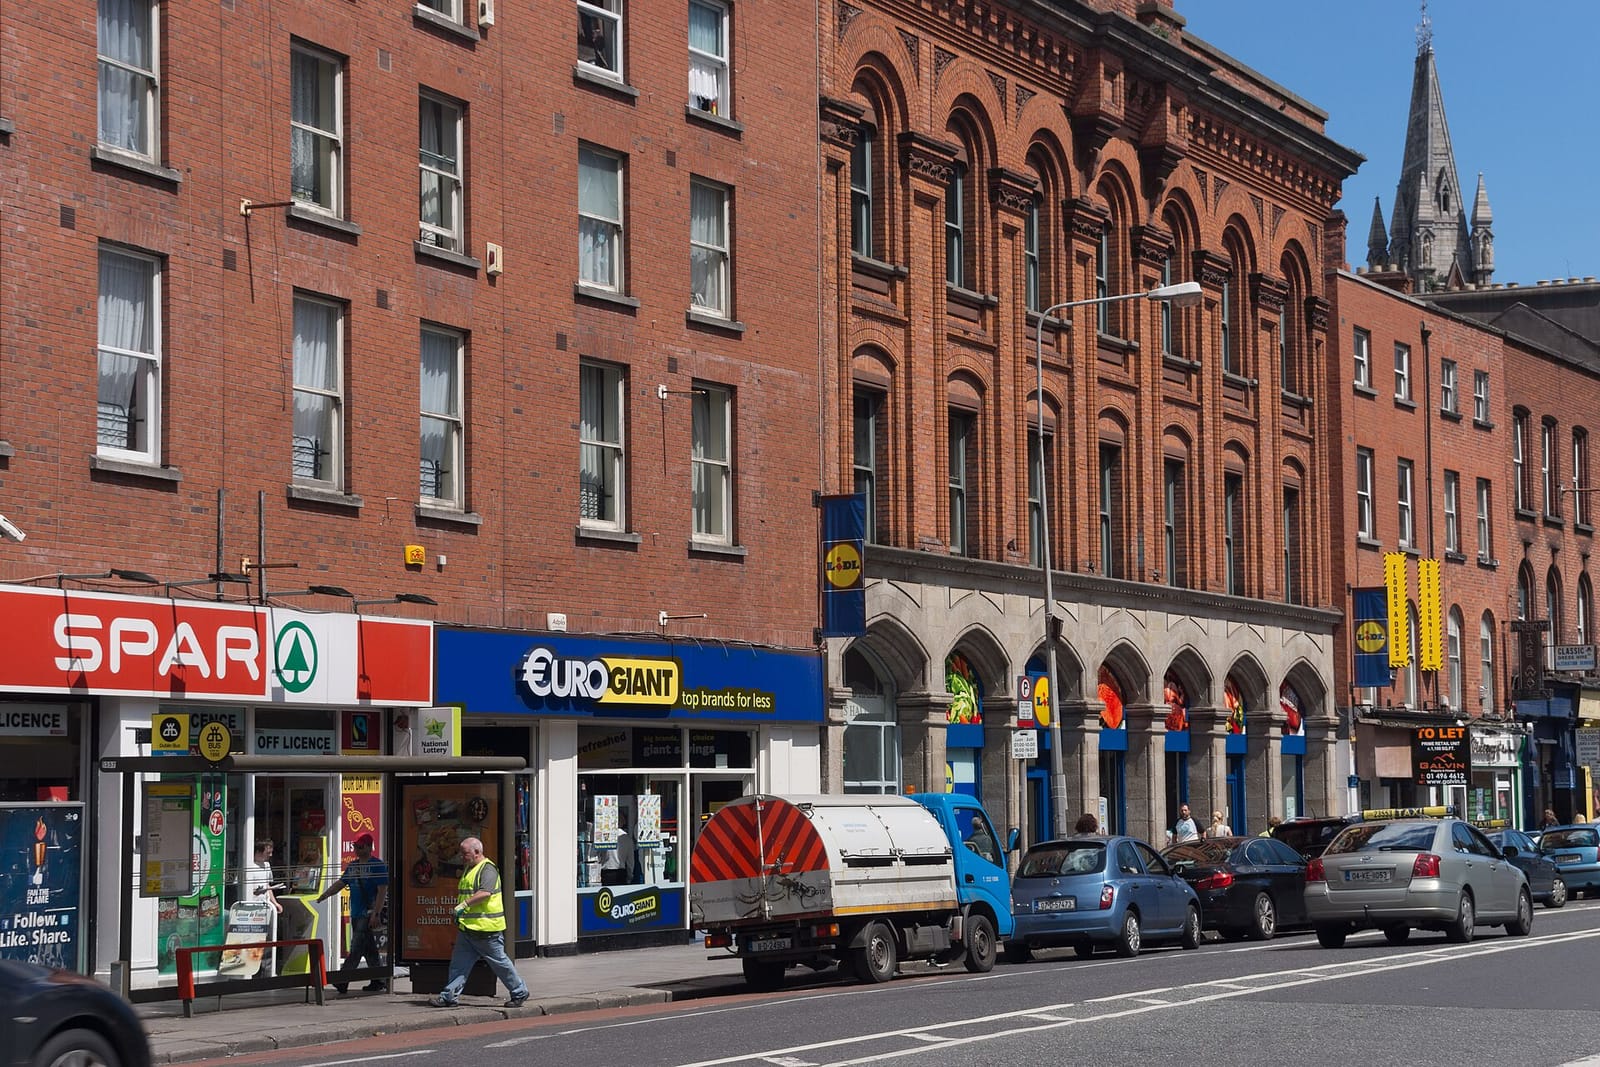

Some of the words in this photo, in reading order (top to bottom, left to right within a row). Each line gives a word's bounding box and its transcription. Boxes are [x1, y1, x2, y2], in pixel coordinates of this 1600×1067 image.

[53, 613, 260, 681] SPAR
[682, 690, 699, 710] top
[701, 690, 735, 707] brands
[737, 691, 751, 708] for
[752, 692, 771, 709] less
[1440, 728, 1465, 739] LET
[257, 736, 279, 749] OFF
[283, 736, 331, 750] LICENCE
[578, 732, 627, 754] refreshed
[643, 743, 674, 757] giant
[675, 743, 716, 757] svings
[355, 776, 365, 791] DAY
[1397, 808, 1423, 817] TAXI
[27, 889, 39, 898] FAN
[39, 888, 50, 897] THE
[27, 896, 49, 905] FLAME
[417, 896, 438, 905] Heat
[599, 891, 612, 913] @
[426, 906, 445, 914] with
[14, 912, 58, 929] Follow.
[417, 916, 452, 925] chicken
[0, 932, 28, 947] Like.
[32, 930, 71, 945] Share.
